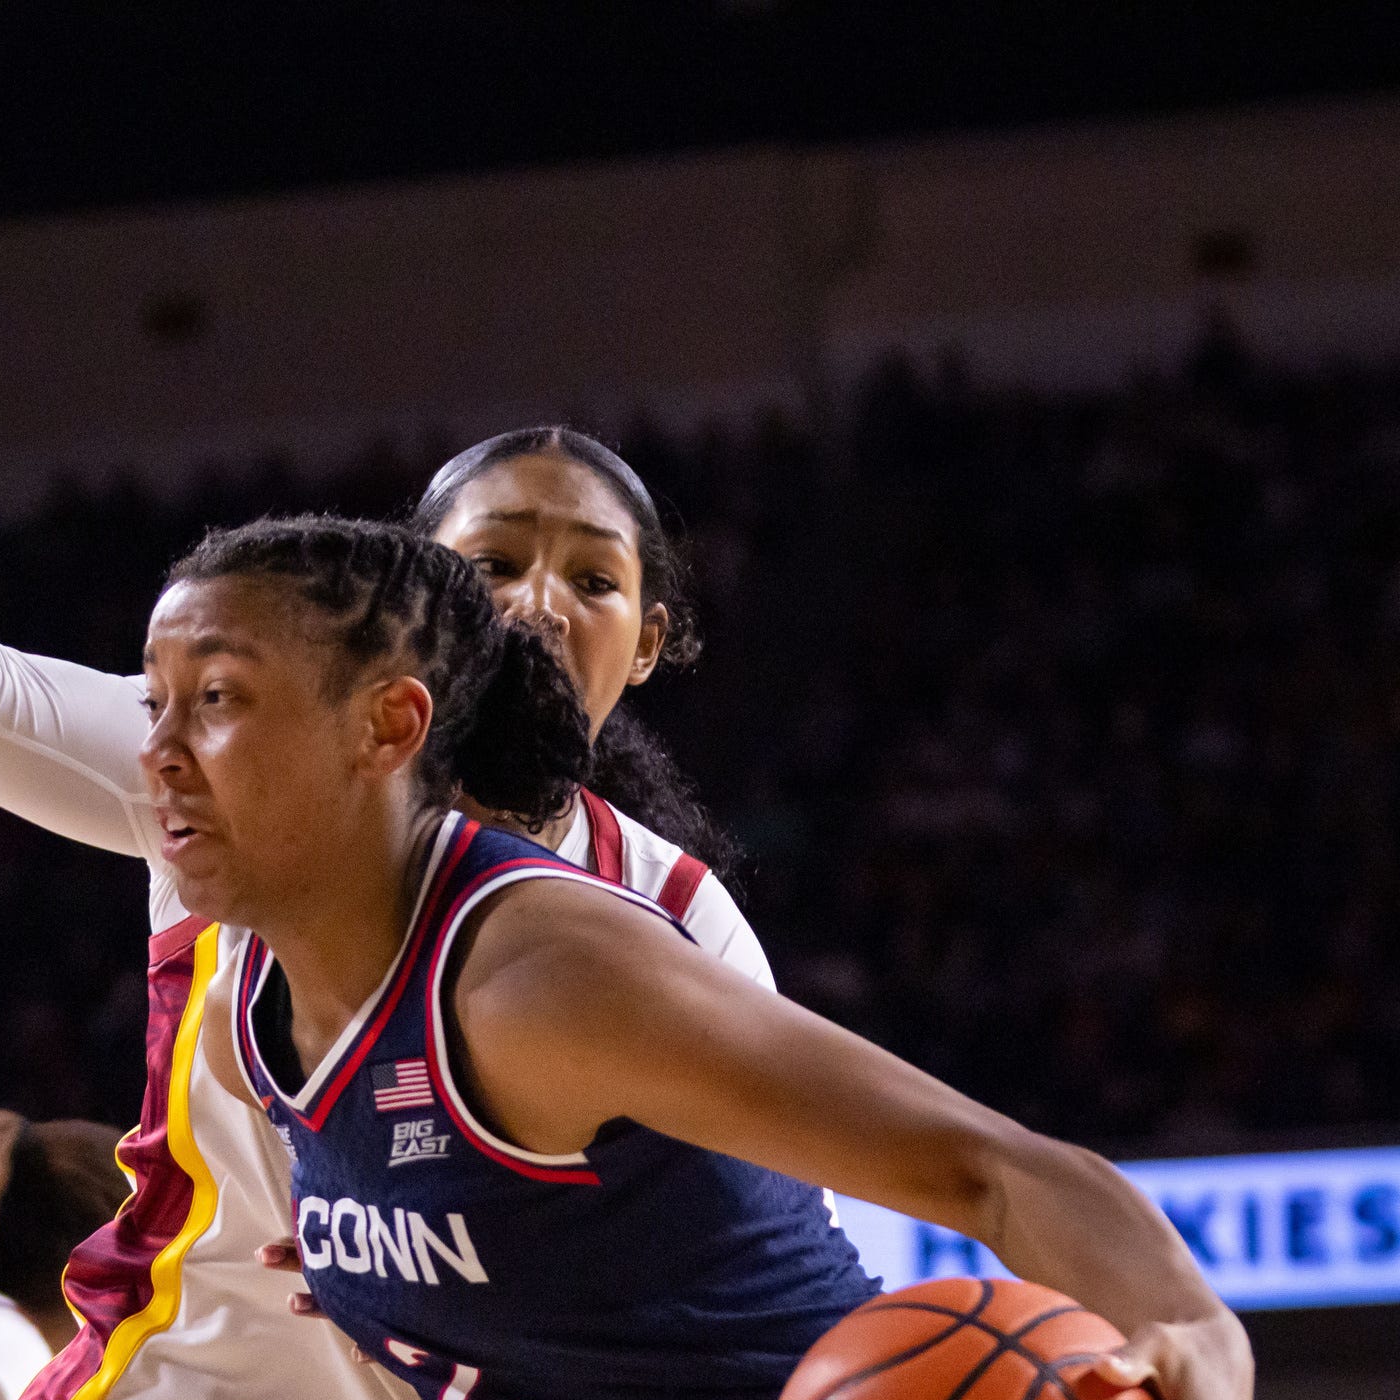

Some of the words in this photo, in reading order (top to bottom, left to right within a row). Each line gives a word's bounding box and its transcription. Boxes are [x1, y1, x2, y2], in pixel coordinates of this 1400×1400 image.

[393, 1118, 435, 1140] BIG
[390, 1134, 452, 1157] EAST
[297, 1195, 490, 1285] CONN
